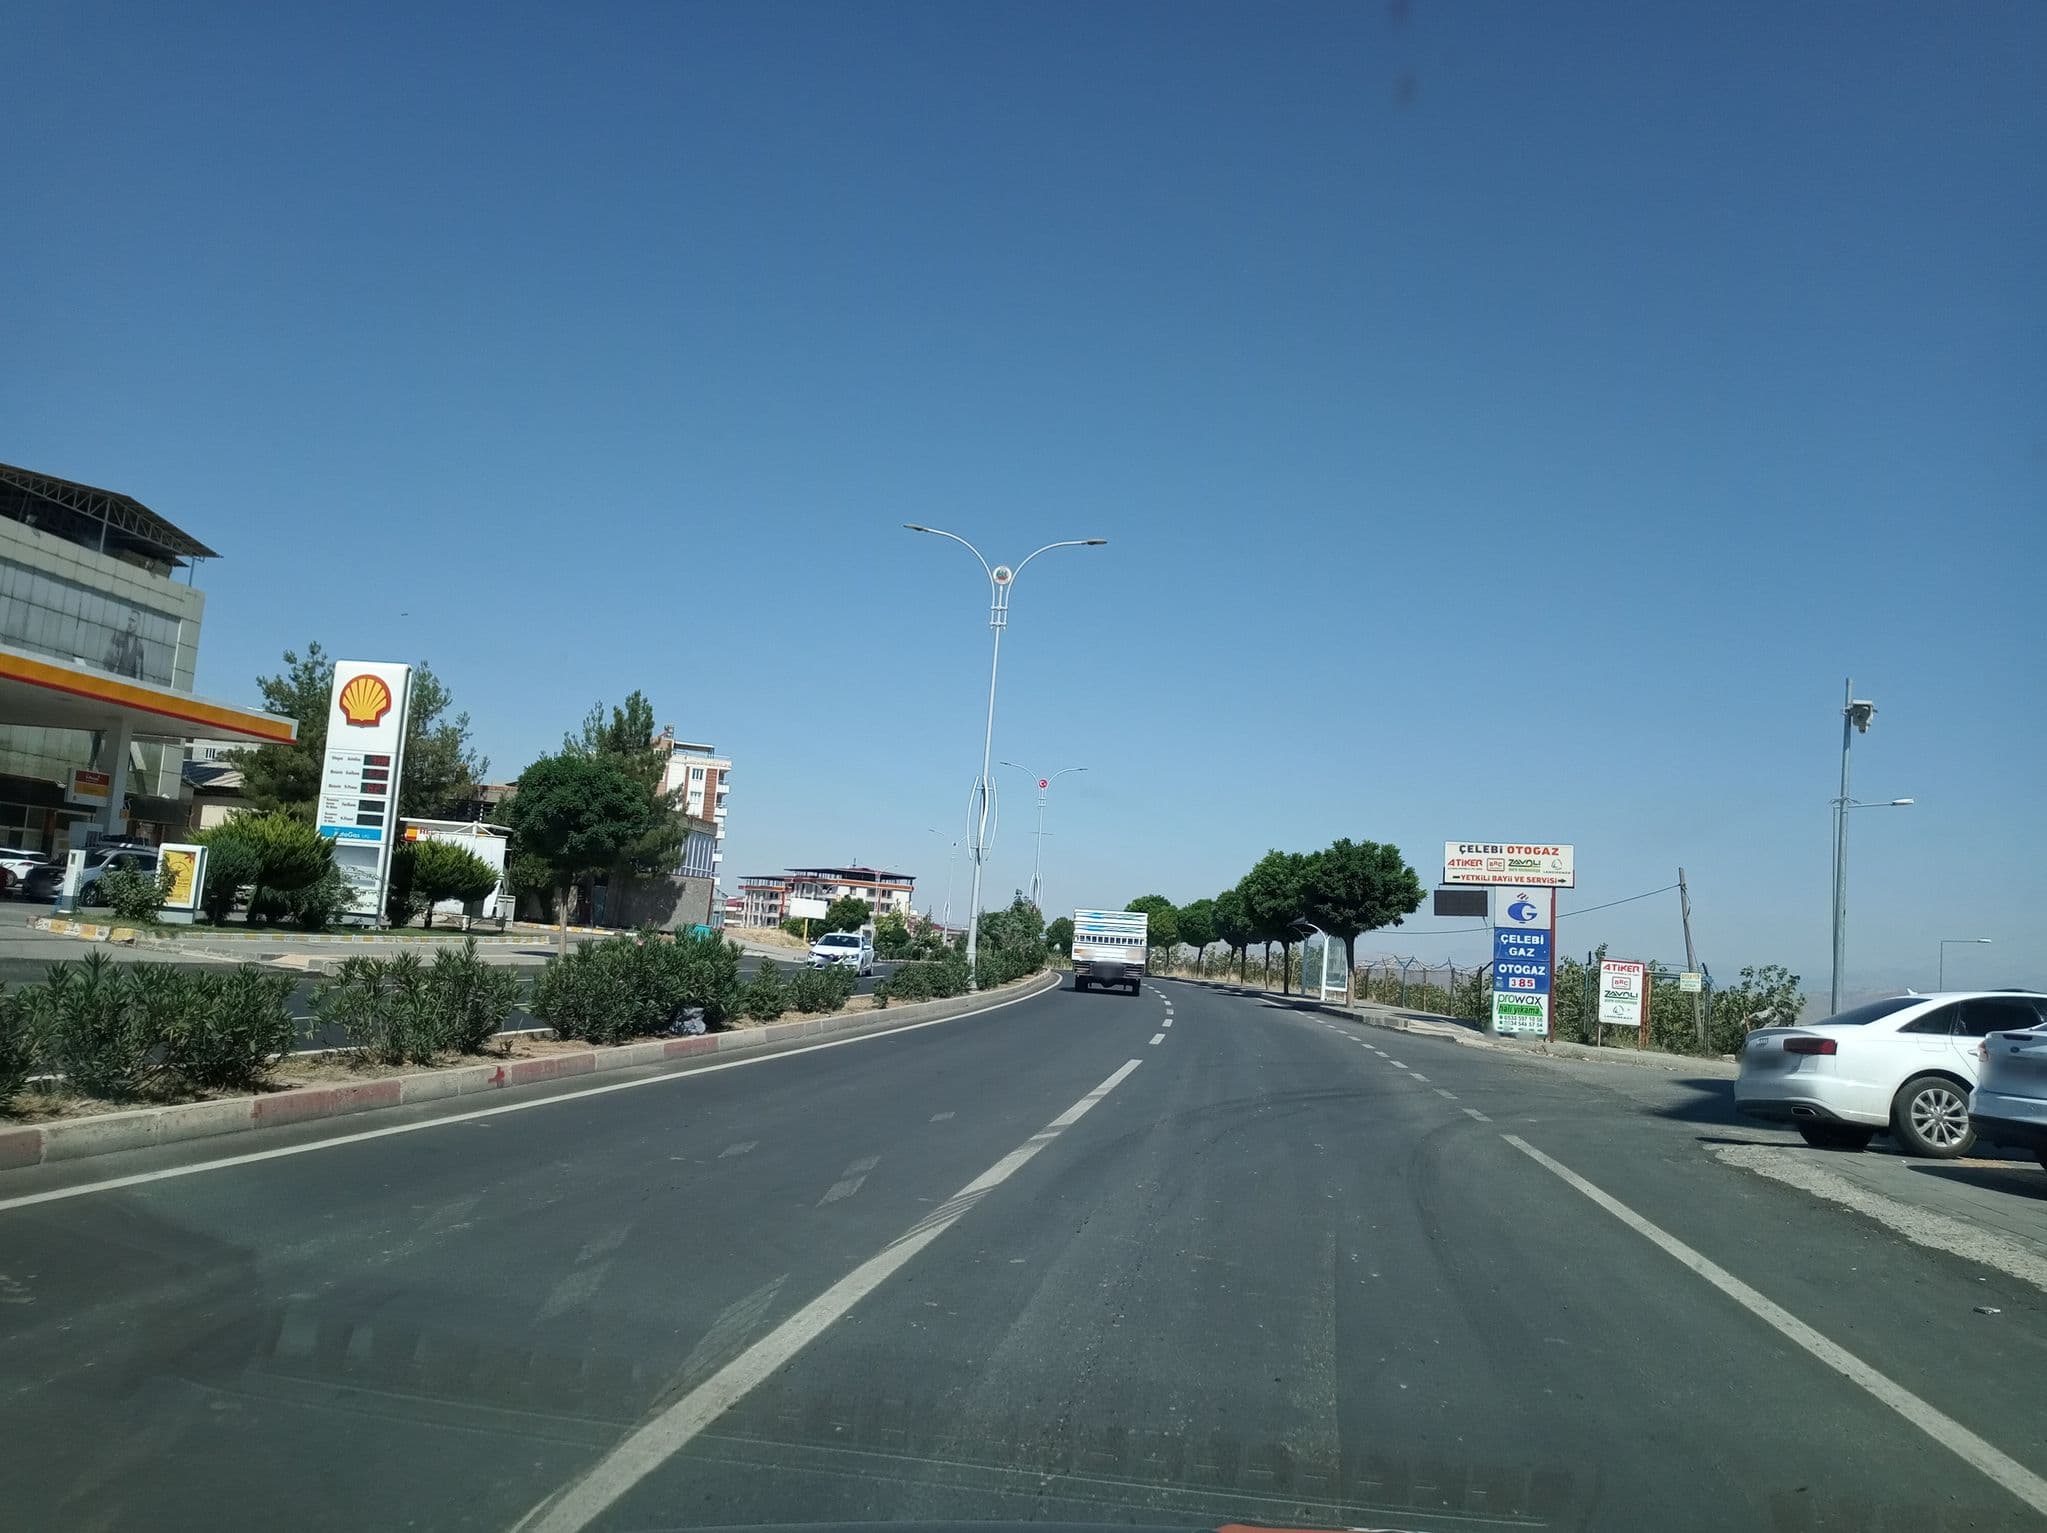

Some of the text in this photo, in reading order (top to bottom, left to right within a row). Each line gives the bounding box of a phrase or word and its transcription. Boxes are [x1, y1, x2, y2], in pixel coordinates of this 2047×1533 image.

[1507, 845, 1560, 856] OTOGAZ
[1509, 947, 1535, 957] GAZ
[1498, 963, 1546, 976] OTOGAZ
[1511, 979, 1534, 988] 385
[1496, 993, 1543, 1010] prowax
